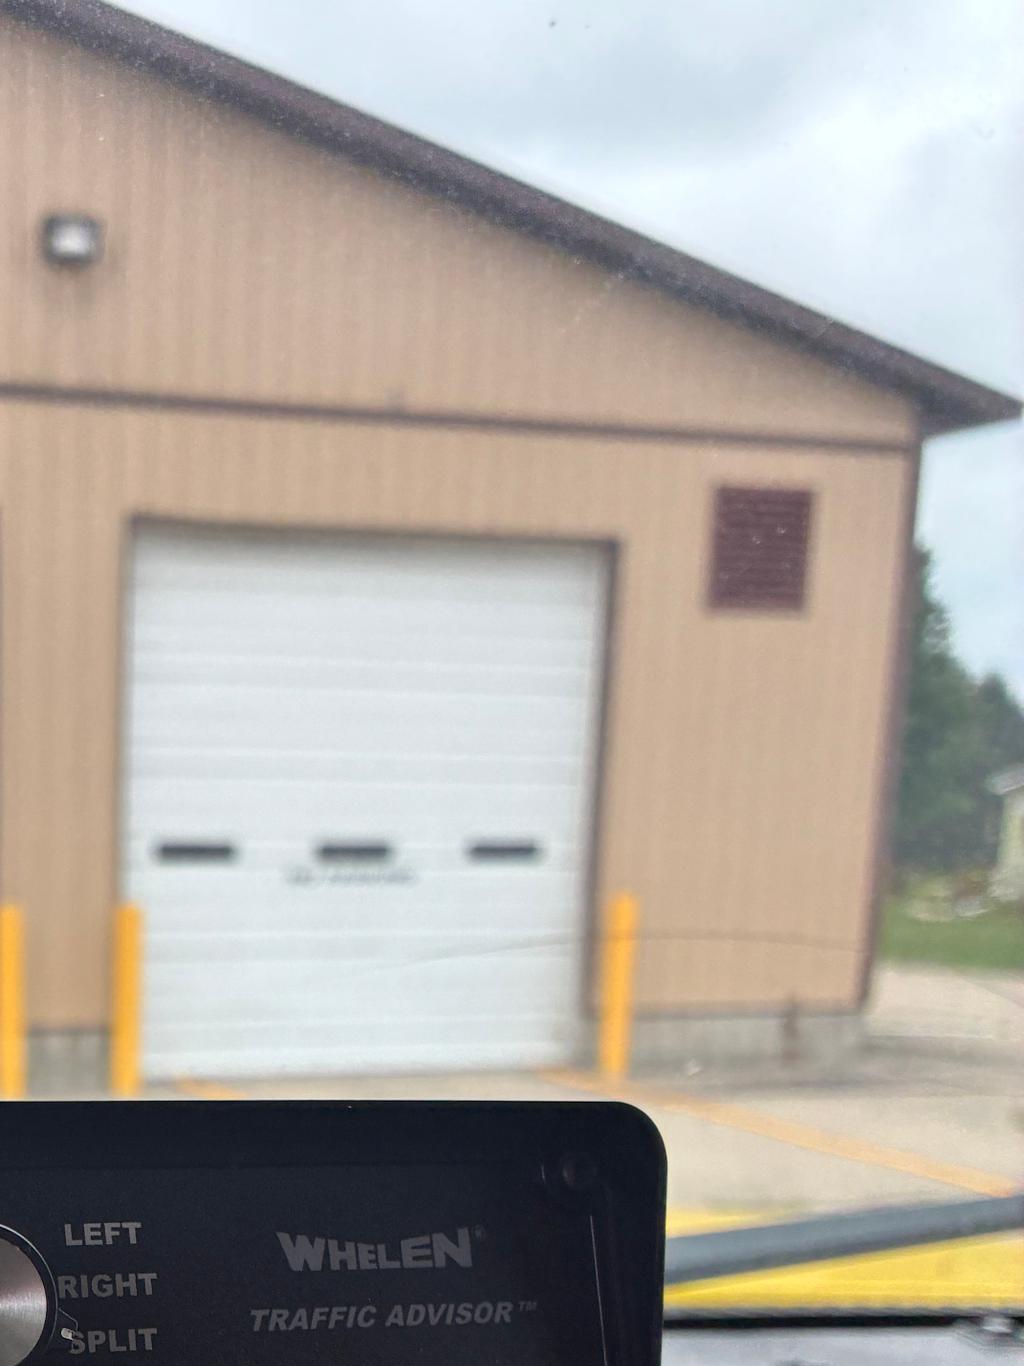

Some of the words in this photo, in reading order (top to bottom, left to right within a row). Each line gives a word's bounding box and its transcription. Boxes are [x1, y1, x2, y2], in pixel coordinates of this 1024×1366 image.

[64, 1221, 142, 1246] LEFT
[57, 1272, 158, 1299] RIGHT
[250, 1305, 376, 1332] TRAFFIC
[68, 1328, 158, 1354] SPLIT
